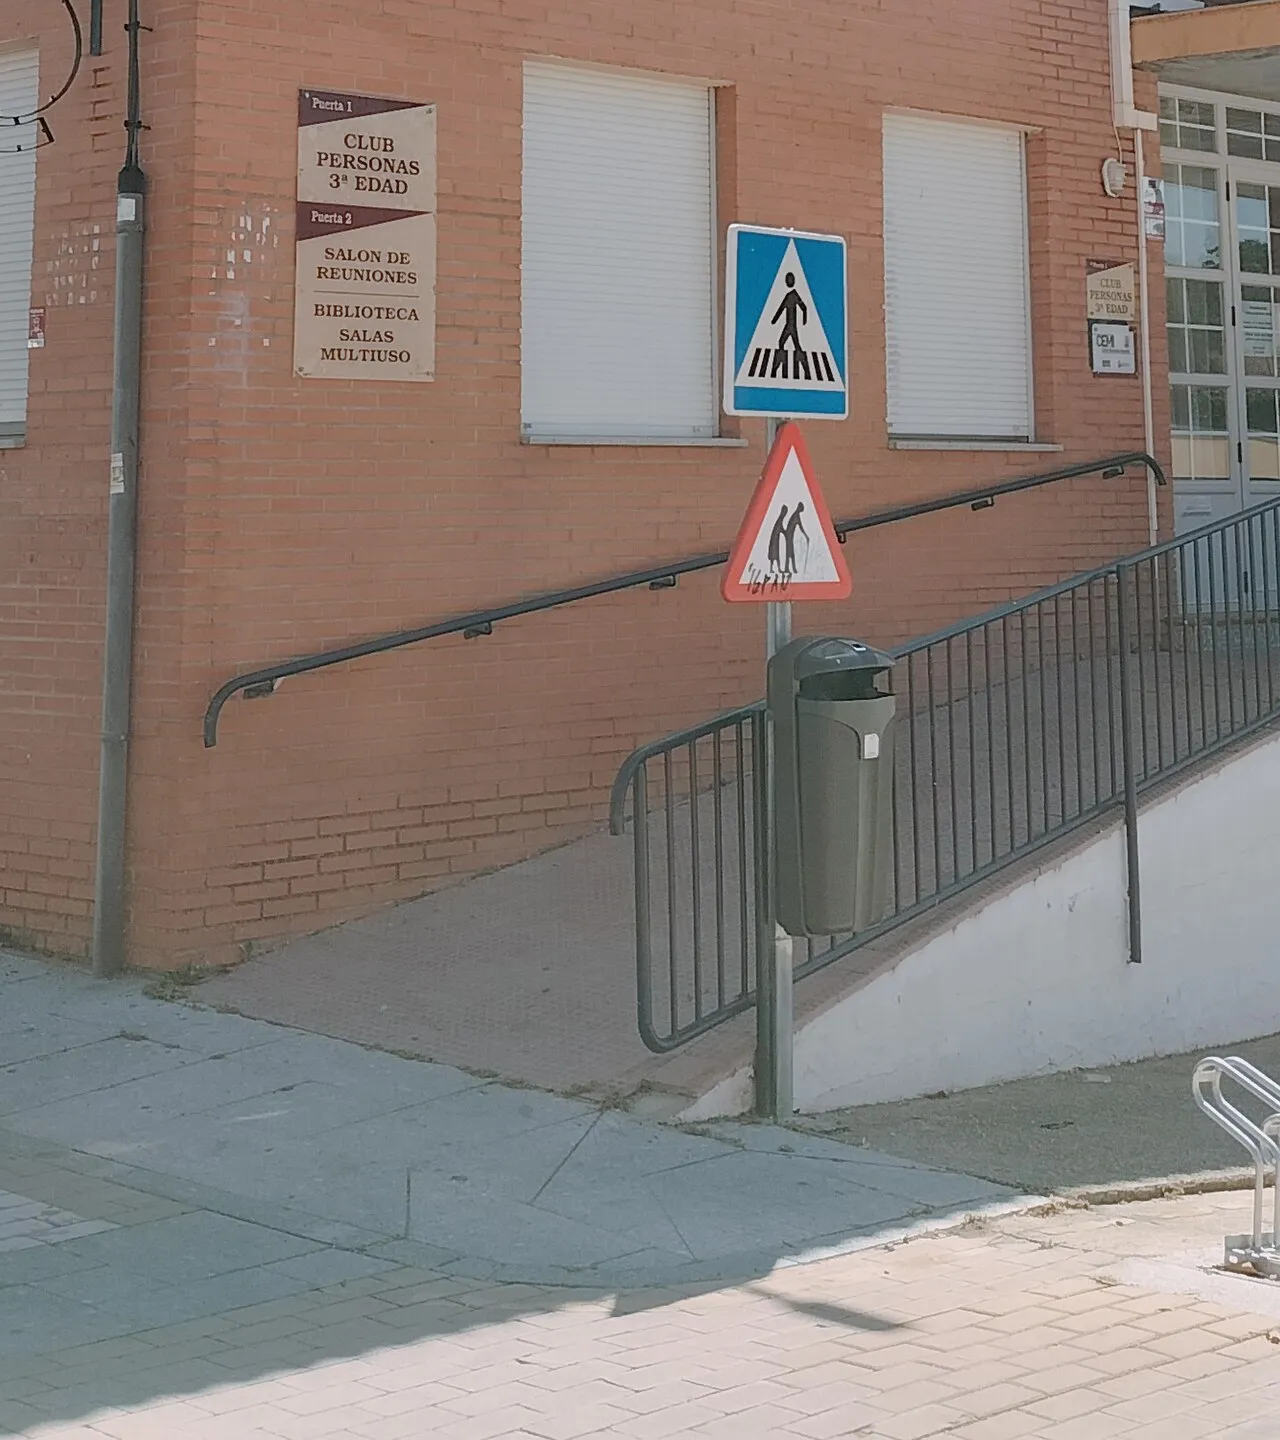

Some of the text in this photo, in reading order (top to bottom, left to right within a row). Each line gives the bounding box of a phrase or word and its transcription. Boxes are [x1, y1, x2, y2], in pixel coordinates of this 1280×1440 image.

[311, 97, 353, 113] Puerta 1
[343, 133, 395, 153] CLUB
[316, 151, 420, 176] PERSONAS
[329, 173, 408, 195] 3ª EDAD
[311, 210, 352, 225] Puerta 2
[324, 247, 411, 265] SALON DE
[316, 266, 418, 285] REUNIONES
[1100, 278, 1121, 289] CLUB
[1089, 289, 1133, 302] PERSONAS
[313, 303, 420, 321] BIBLIOTECA
[1105, 303, 1128, 314] EDAD
[339, 328, 395, 343] SALAS
[320, 347, 411, 363] MULTIUSO
